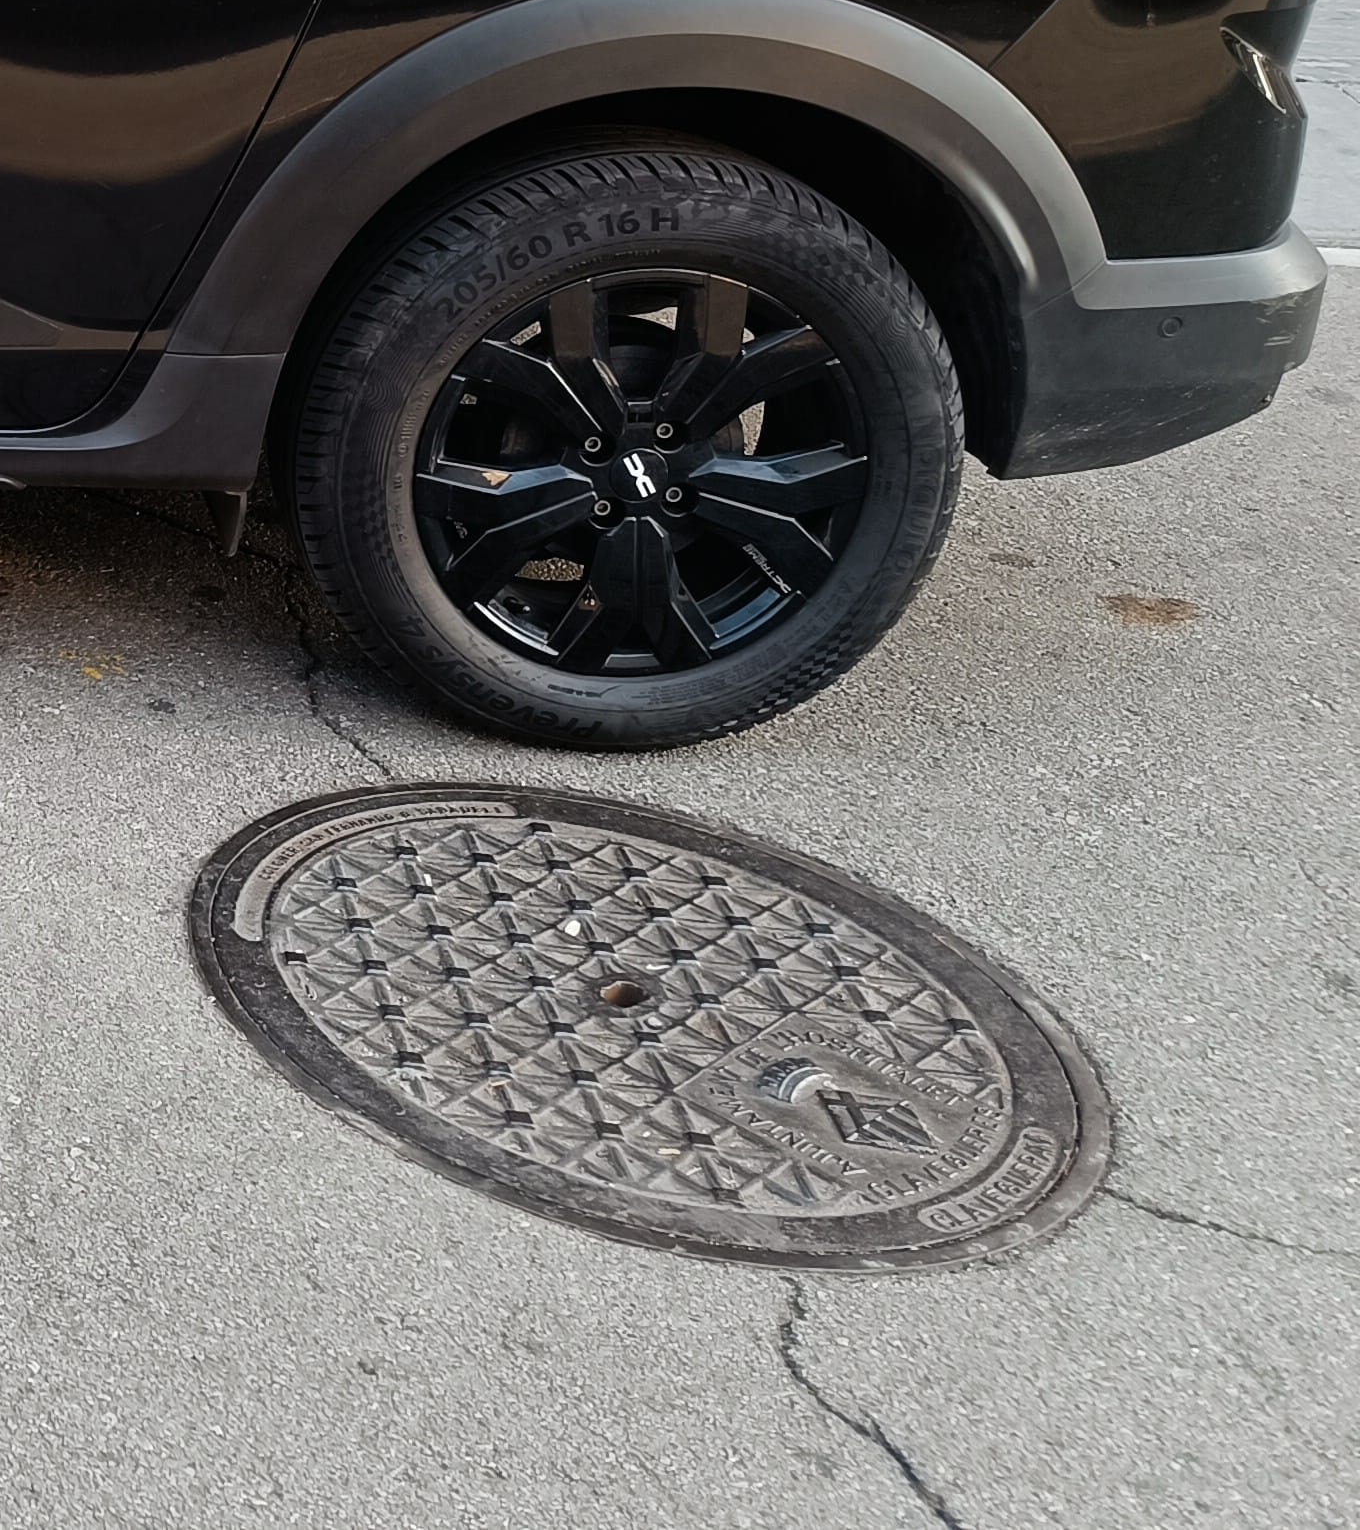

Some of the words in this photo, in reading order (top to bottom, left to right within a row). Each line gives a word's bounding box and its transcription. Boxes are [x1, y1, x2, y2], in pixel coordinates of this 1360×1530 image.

[432, 234, 553, 320] 205/60
[562, 221, 592, 247] R
[597, 210, 641, 237] 16
[650, 207, 680, 232] H
